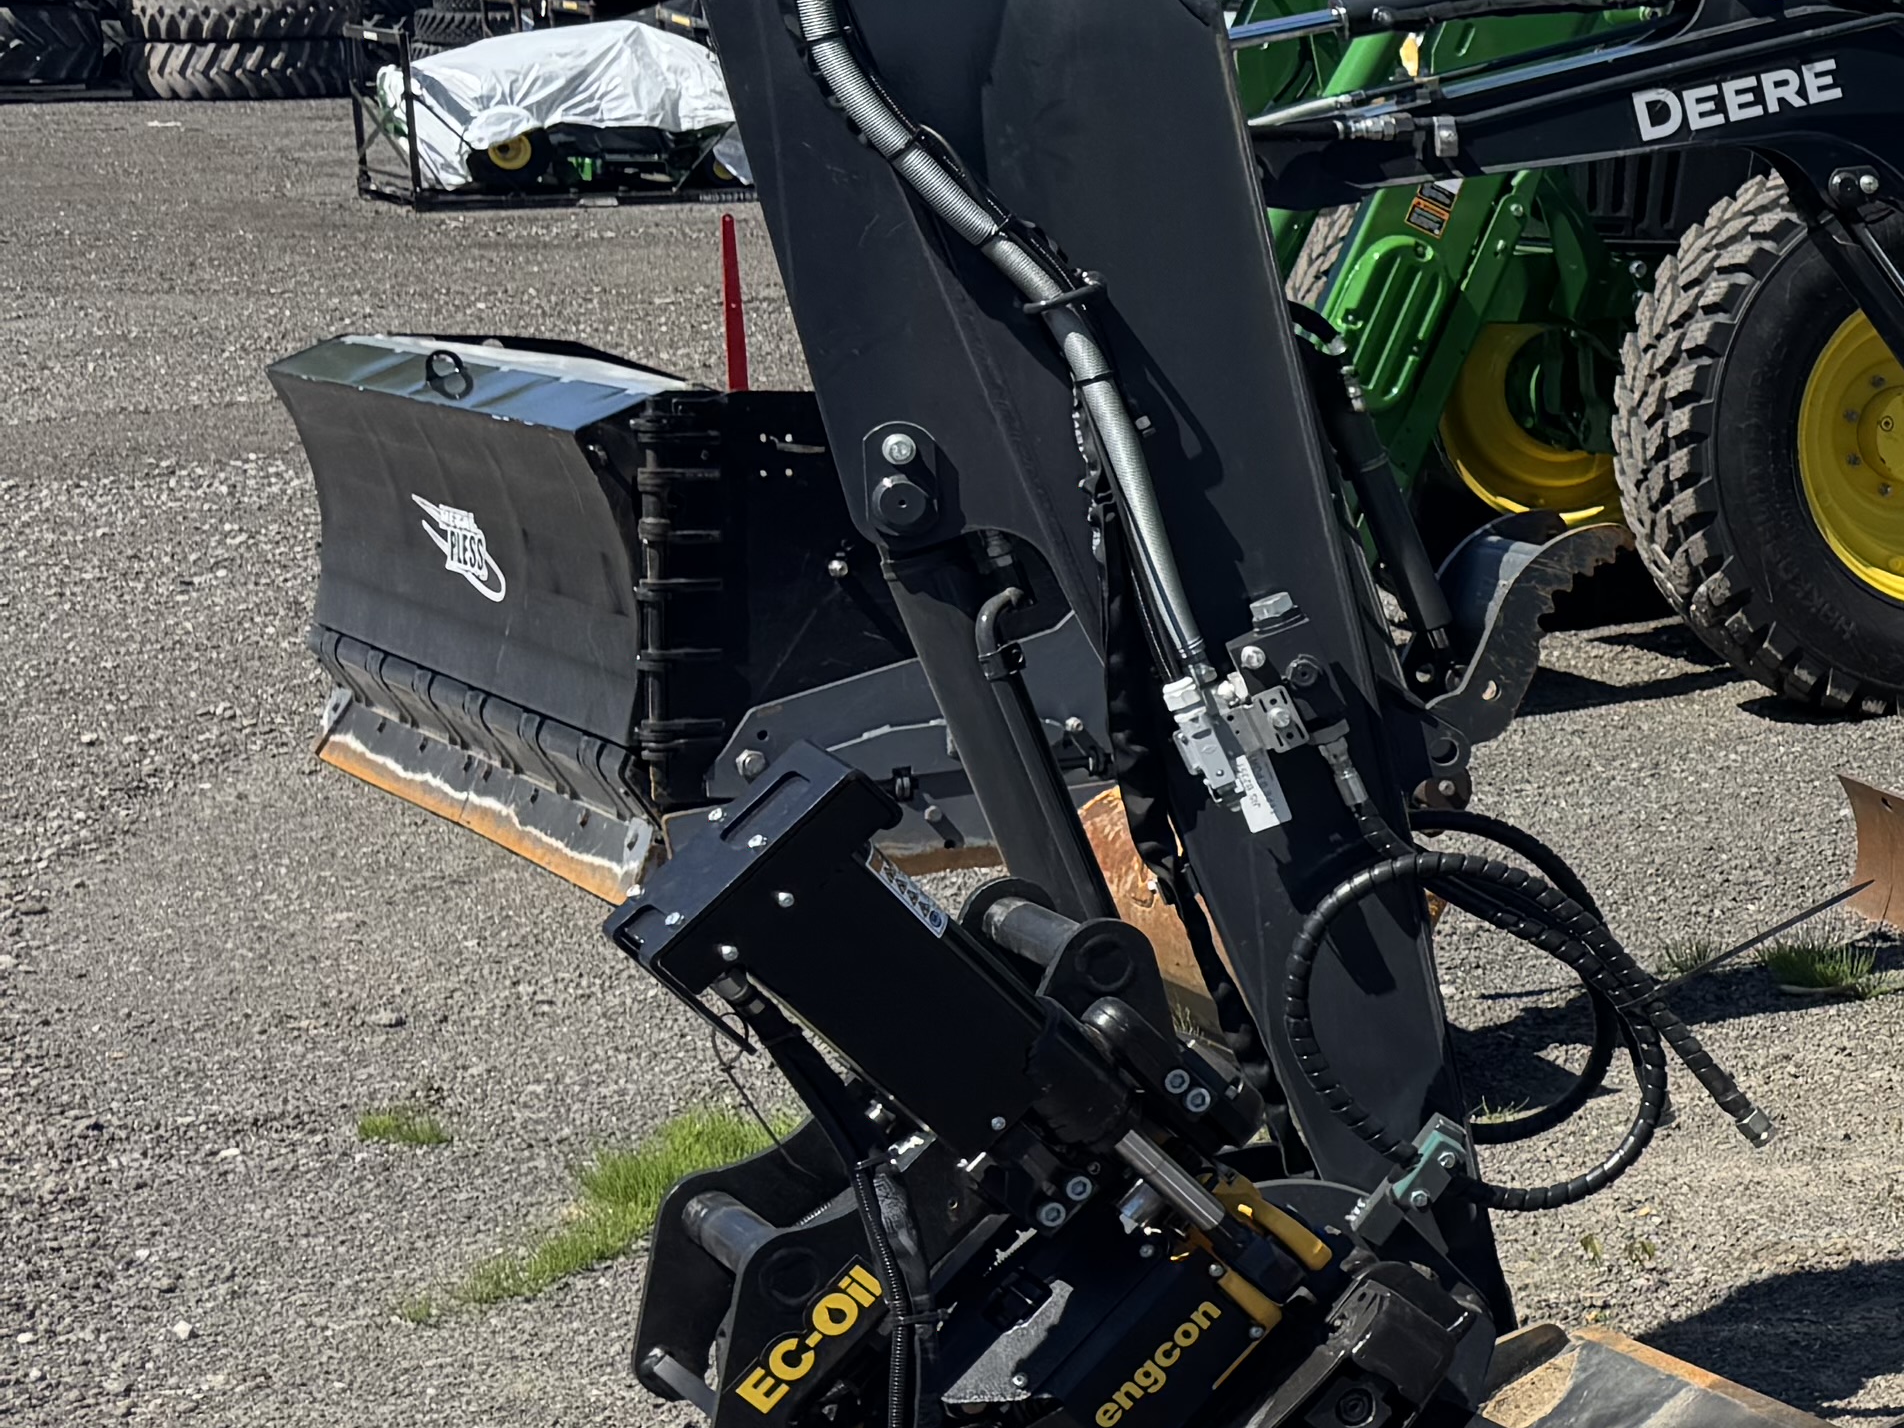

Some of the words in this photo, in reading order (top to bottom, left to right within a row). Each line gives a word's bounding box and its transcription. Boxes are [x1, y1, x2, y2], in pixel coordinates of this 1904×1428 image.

[1631, 58, 1843, 142] DEERE
[450, 529, 484, 571] PLESS
[735, 1264, 883, 1414] EC-Oil
[1095, 1299, 1222, 1428] engcon
